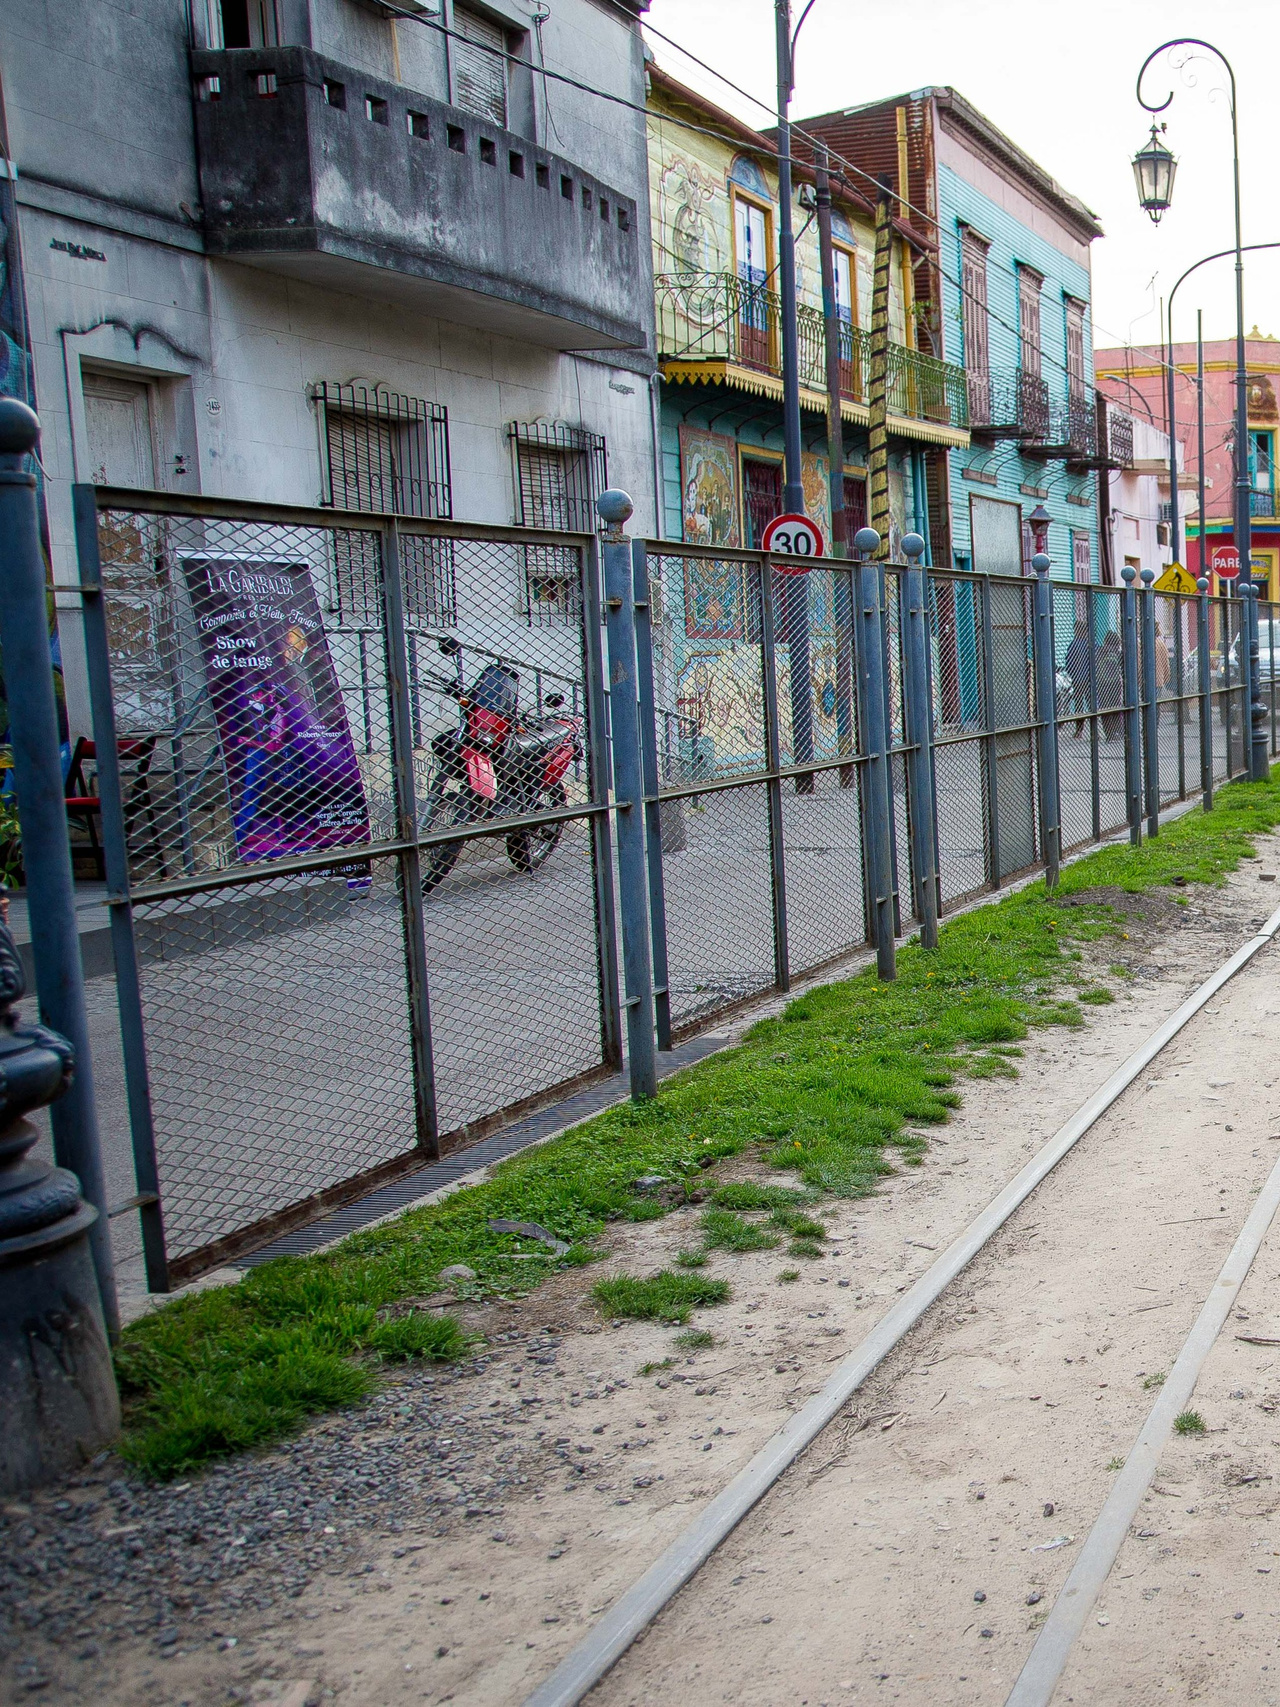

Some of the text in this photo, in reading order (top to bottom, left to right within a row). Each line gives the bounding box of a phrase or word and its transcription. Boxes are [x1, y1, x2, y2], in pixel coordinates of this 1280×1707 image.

[775, 532, 811, 555] 30
[1214, 558, 1240, 568] PARE
[216, 635, 256, 650] Show
[212, 654, 231, 669] de
